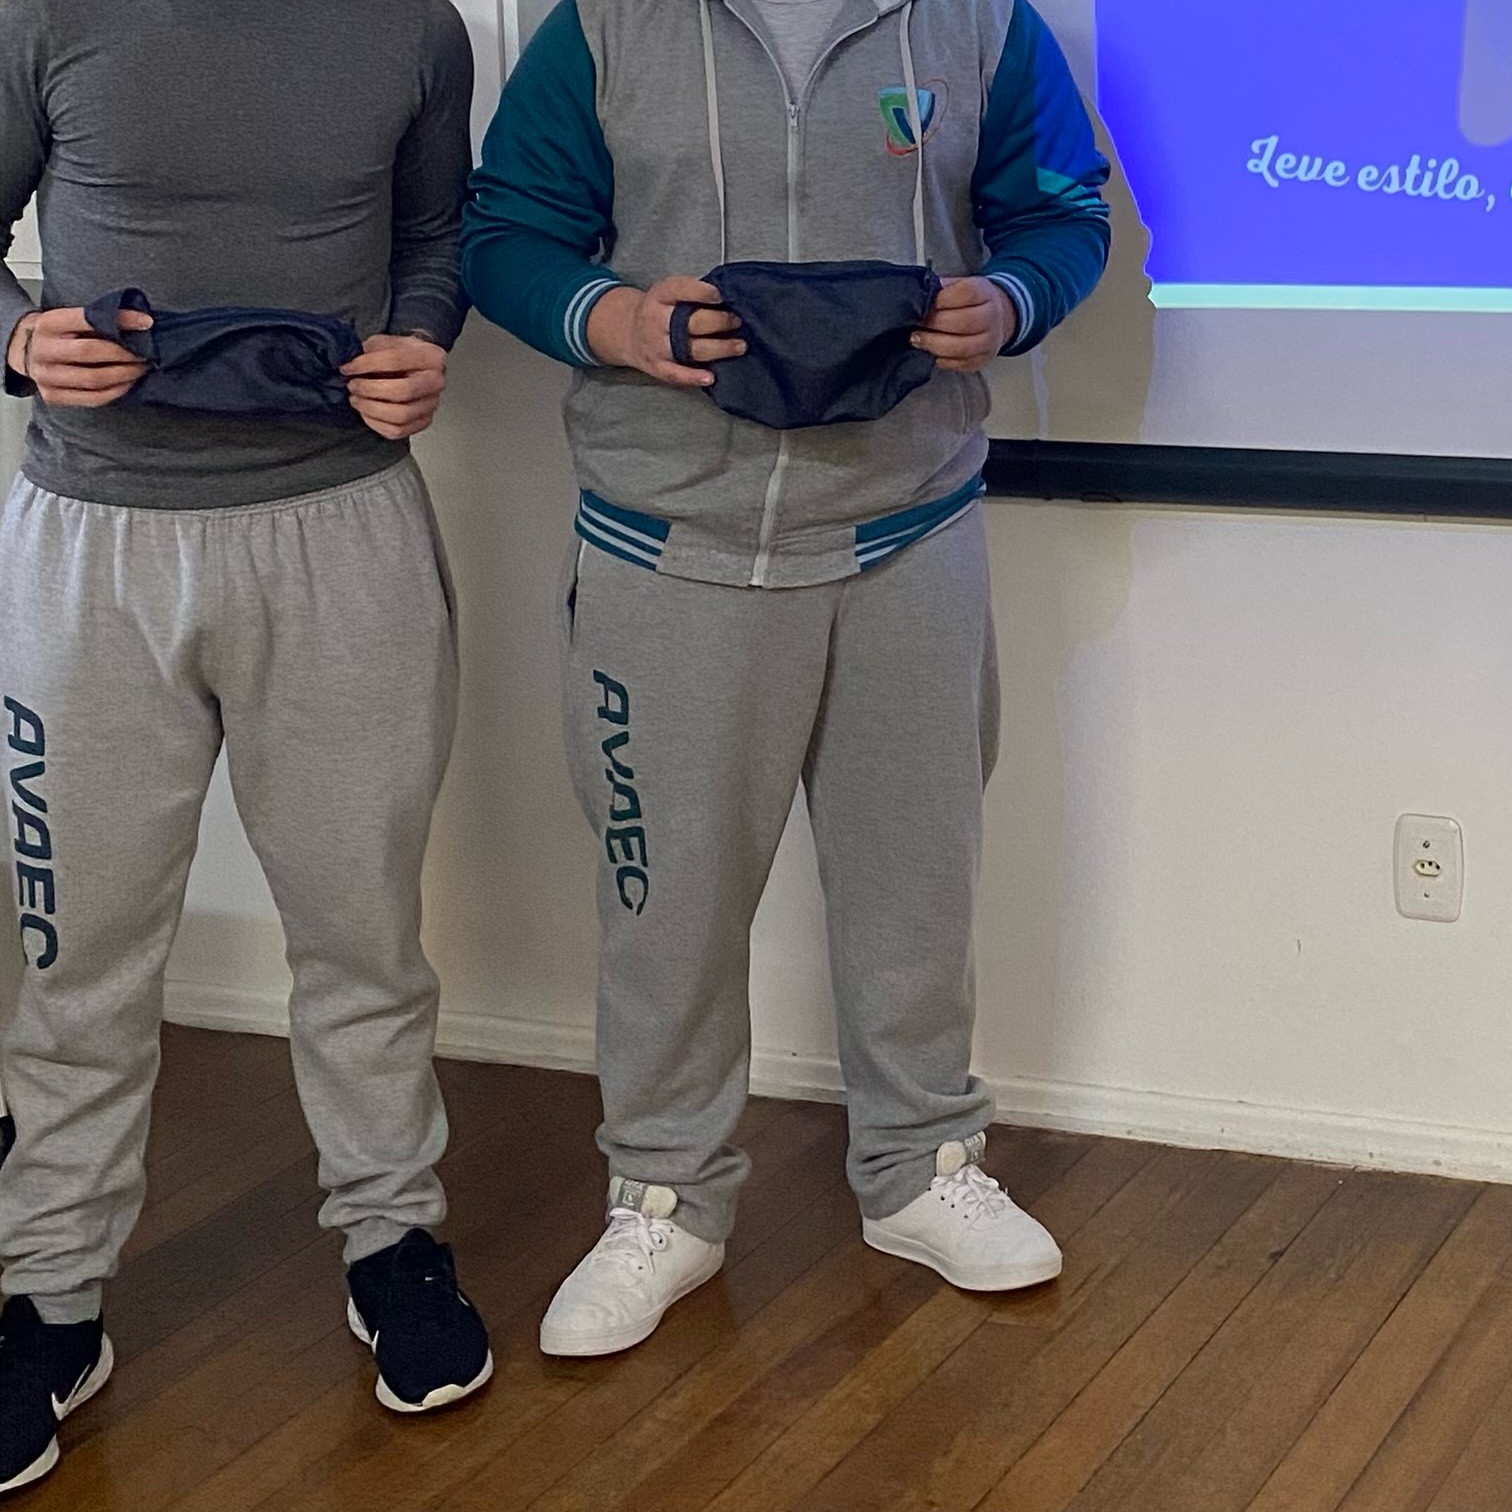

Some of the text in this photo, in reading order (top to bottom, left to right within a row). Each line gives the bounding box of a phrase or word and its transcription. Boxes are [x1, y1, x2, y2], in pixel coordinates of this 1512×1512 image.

[1246, 134, 1350, 189] Leve
[1357, 157, 1497, 214] estilo,
[4, 694, 58, 970] AVAEC
[593, 669, 649, 916] AVAEC
